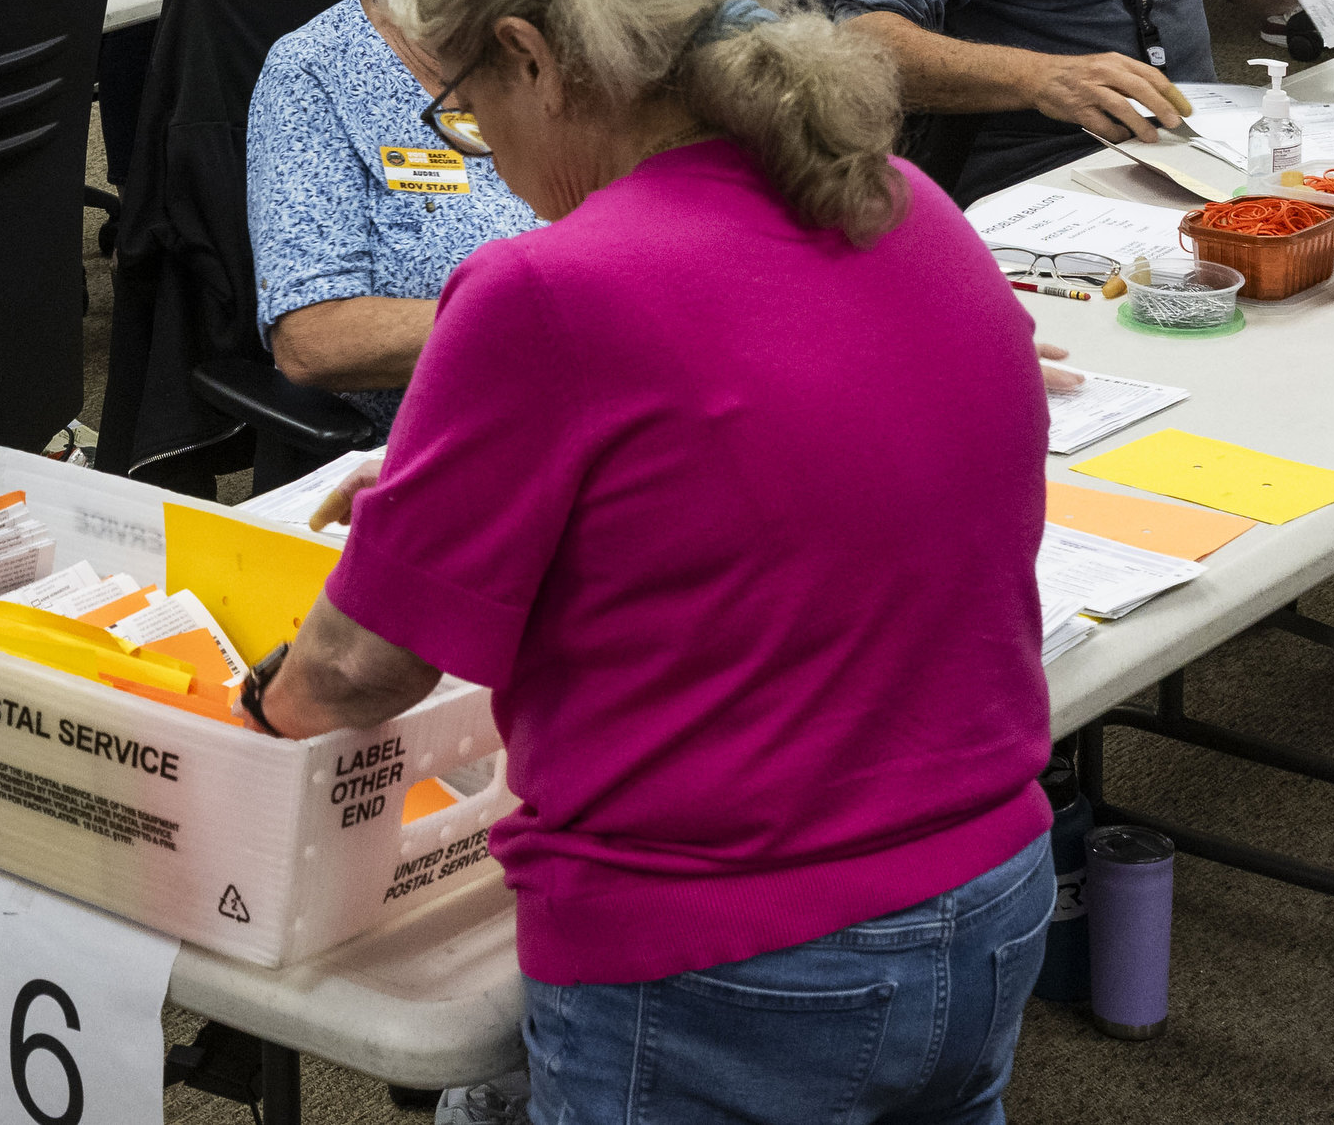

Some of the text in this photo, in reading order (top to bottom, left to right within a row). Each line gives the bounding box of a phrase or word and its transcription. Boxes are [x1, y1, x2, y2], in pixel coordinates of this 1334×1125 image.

[399, 182, 459, 192] ROV STAFF
[980, 194, 1066, 235] PROBLEM BALLOTS
[58, 719, 180, 782] SERVICE
[335, 736, 406, 777] LABEL
[330, 761, 404, 806] OTHER
[341, 794, 386, 829] END
[393, 848, 445, 883] UNITED
[383, 868, 435, 904] POSTAL
[230, 898, 238, 912] 2
